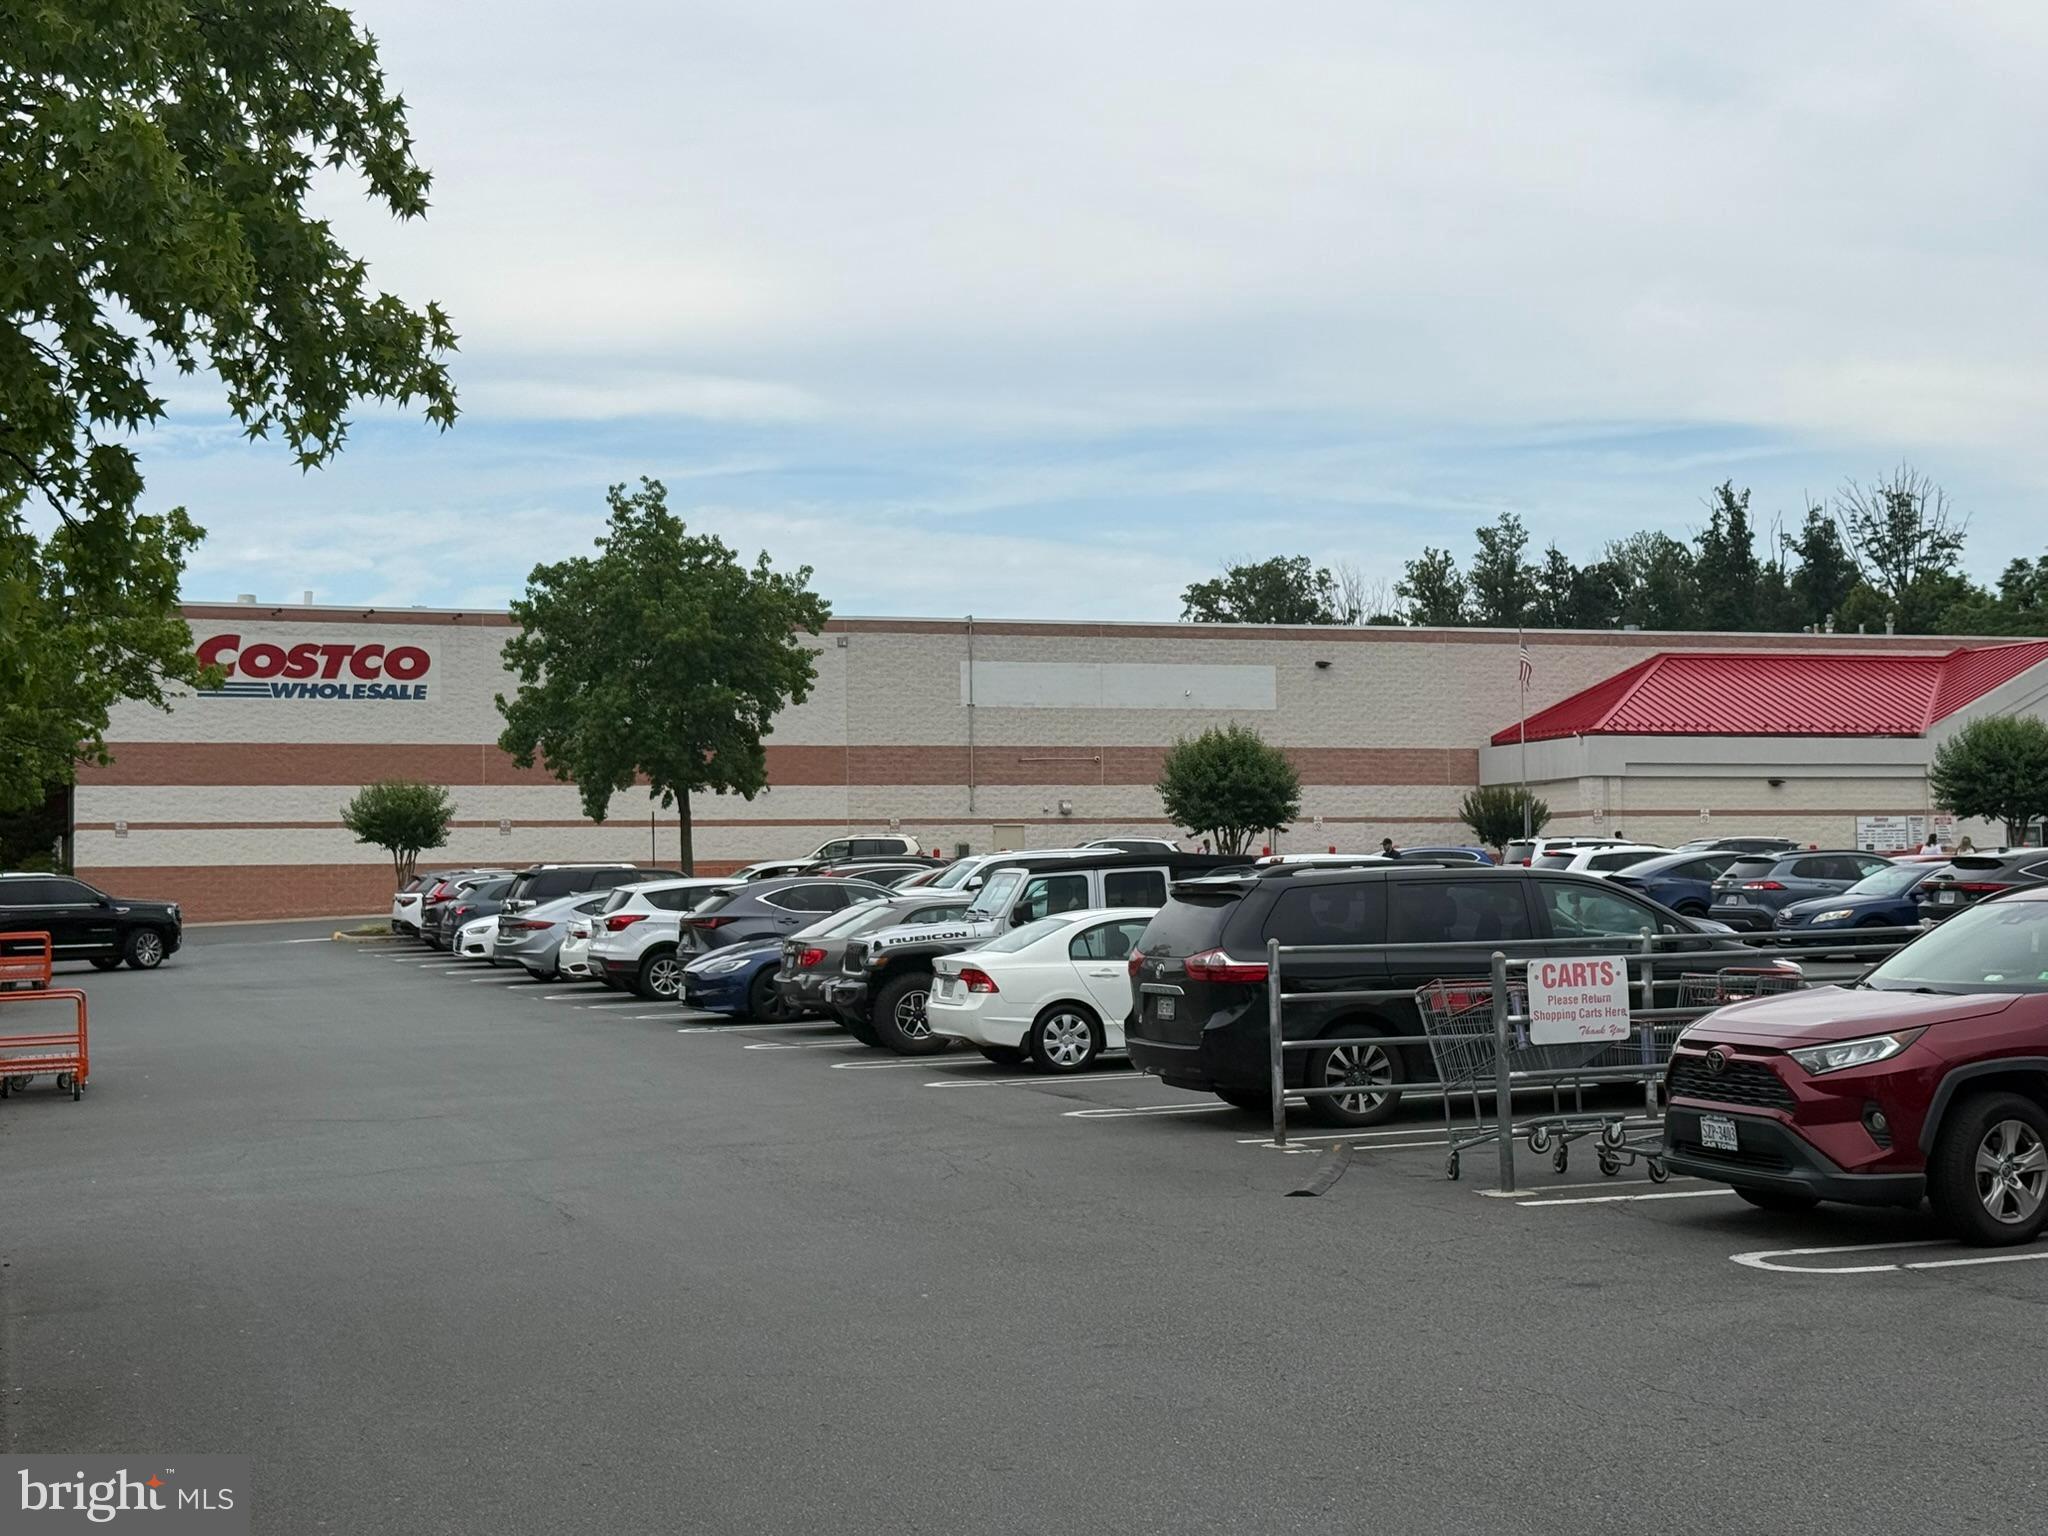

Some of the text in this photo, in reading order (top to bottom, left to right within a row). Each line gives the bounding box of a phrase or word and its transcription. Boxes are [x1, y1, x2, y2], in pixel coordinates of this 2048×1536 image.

[195, 634, 431, 681] COSTCO
[270, 682, 428, 700] WHOLESALE
[889, 931, 967, 945] RUBICON
[1541, 961, 1614, 989] CARTS
[1547, 993, 1612, 1006] Please Return
[1533, 1010, 1577, 1022] Shopping
[1578, 1007, 1602, 1019] Carts
[1579, 1024, 1626, 1036] Thank You
